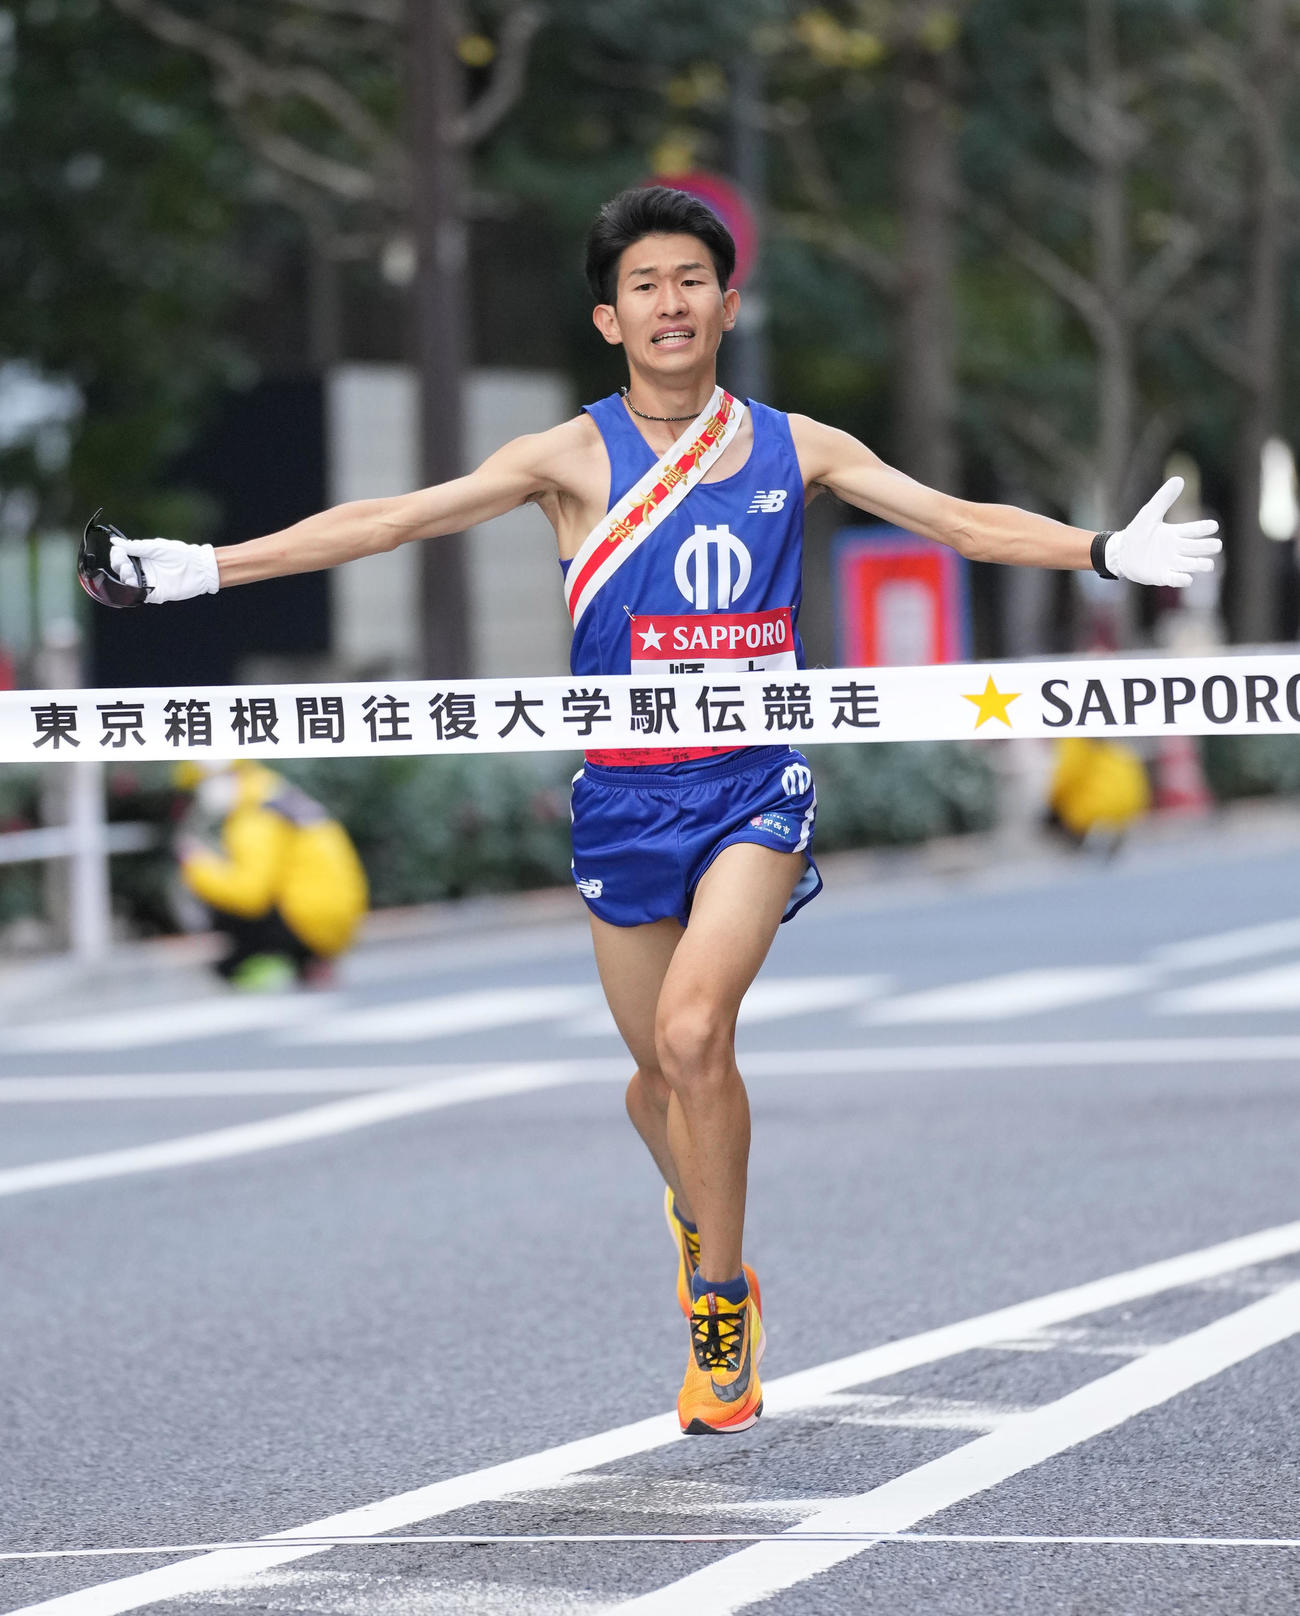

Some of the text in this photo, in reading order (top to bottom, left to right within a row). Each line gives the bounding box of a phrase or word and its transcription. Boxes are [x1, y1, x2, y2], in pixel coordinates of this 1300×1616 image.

[672, 619, 786, 651] SAPPORO
[30, 681, 881, 750] 東京箱根間往復大学駅伝競走
